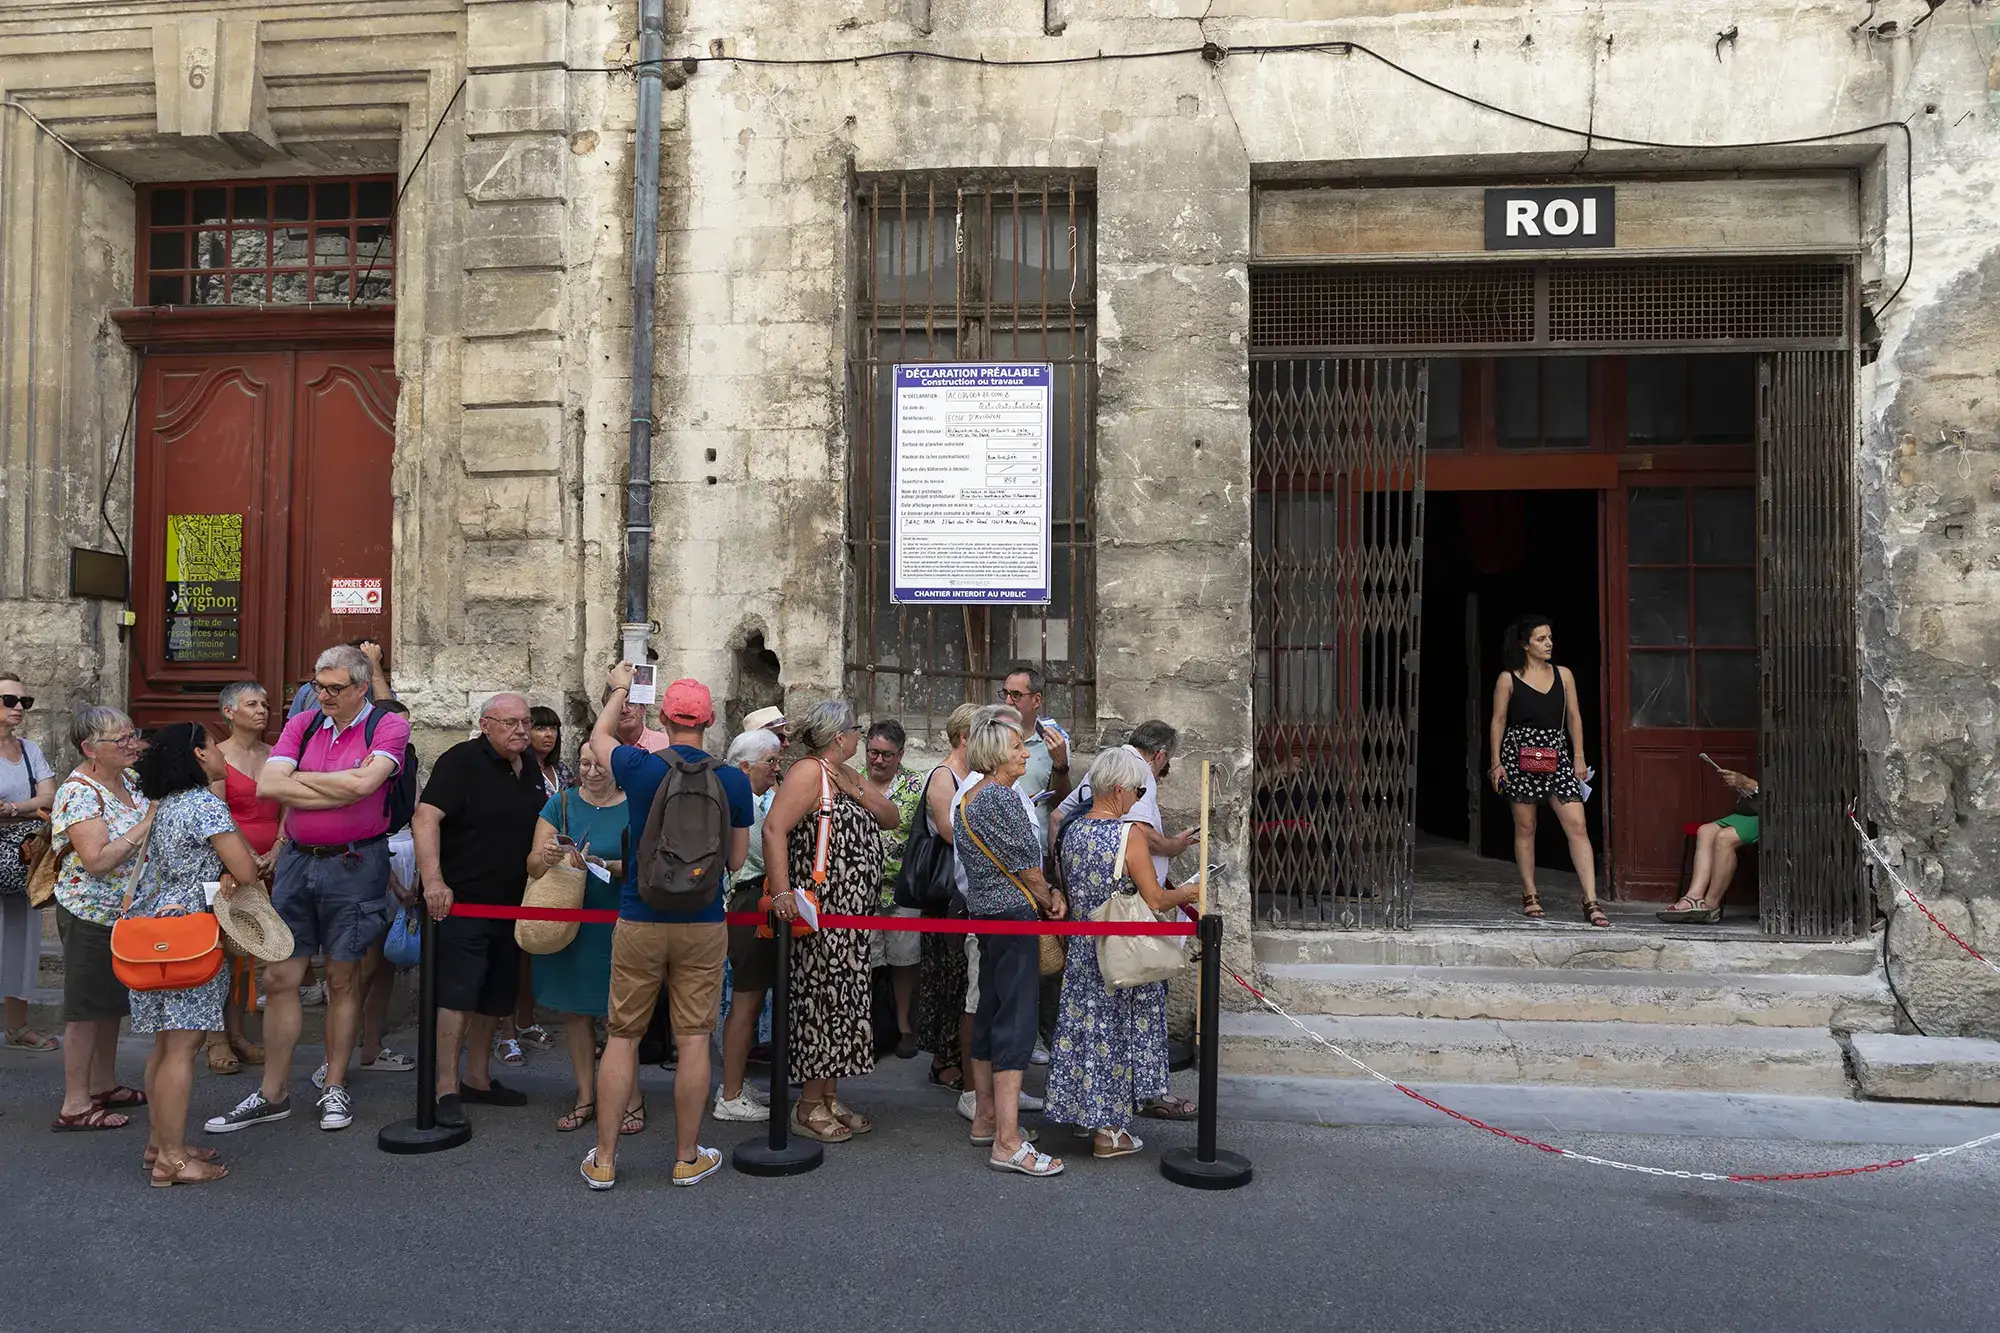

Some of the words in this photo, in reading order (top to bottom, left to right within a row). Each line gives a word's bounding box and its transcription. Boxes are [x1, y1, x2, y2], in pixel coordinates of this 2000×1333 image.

[189, 64, 206, 90] 6
[1506, 198, 1597, 236] ROI
[905, 368, 978, 378] DÉCLARATION
[981, 366, 1040, 378] PRÉALABLE
[921, 378, 976, 386] Construction
[332, 580, 362, 588] PROPRIETE
[364, 580, 381, 588] SOUS
[174, 596, 236, 613] Avignon
[183, 618, 210, 627] Centre
[212, 618, 222, 627] de
[229, 629, 237, 637] le
[180, 640, 224, 648] Patrimoine
[196, 650, 224, 658] Ancien
